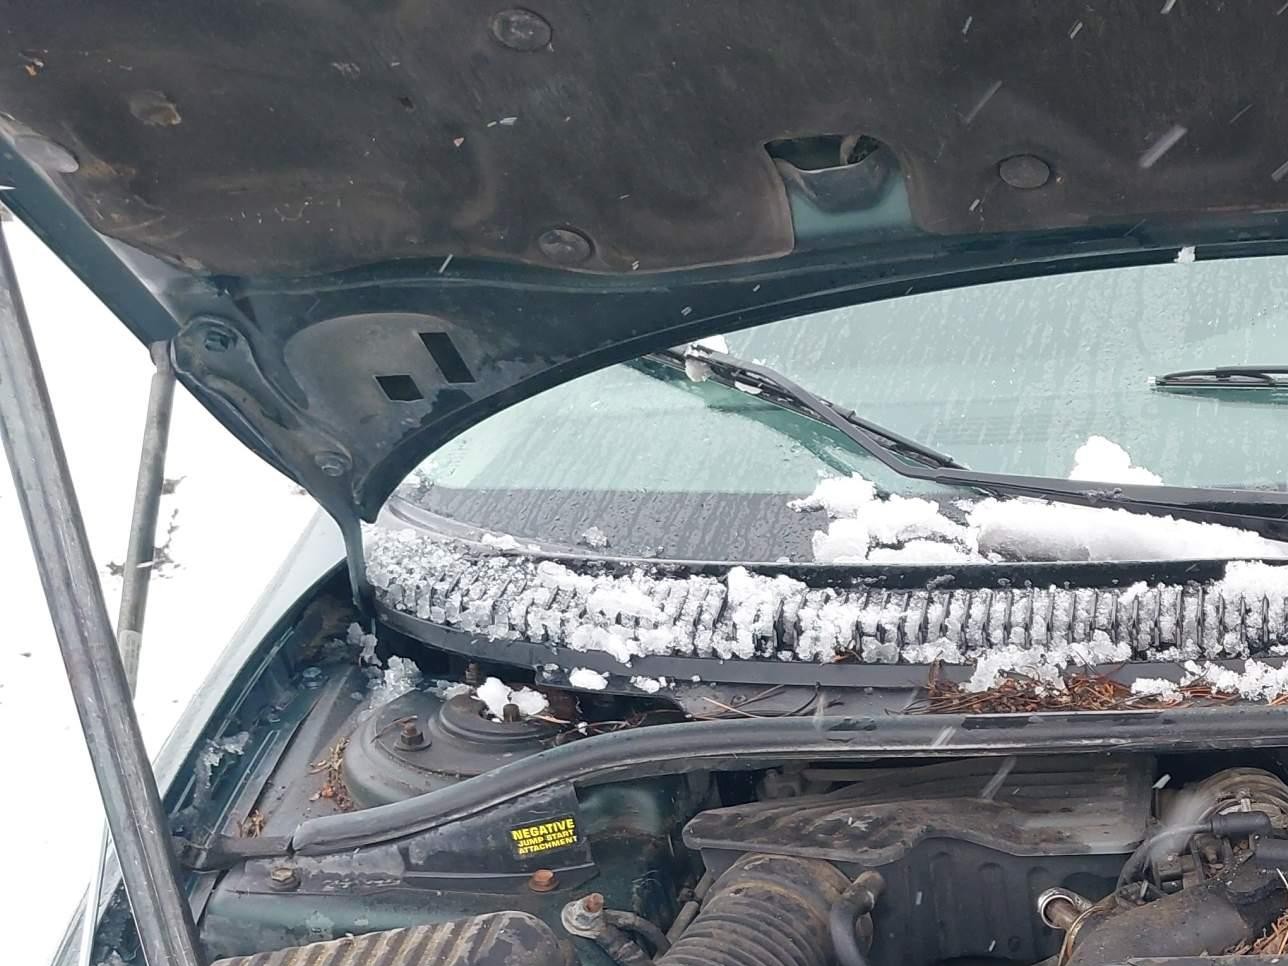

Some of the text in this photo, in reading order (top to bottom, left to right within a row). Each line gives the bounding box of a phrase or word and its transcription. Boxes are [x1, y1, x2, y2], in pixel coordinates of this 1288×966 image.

[511, 818, 575, 840] NEGATIVE
[518, 830, 574, 847] JUMP START
[519, 836, 577, 854] ATTACHMENT
